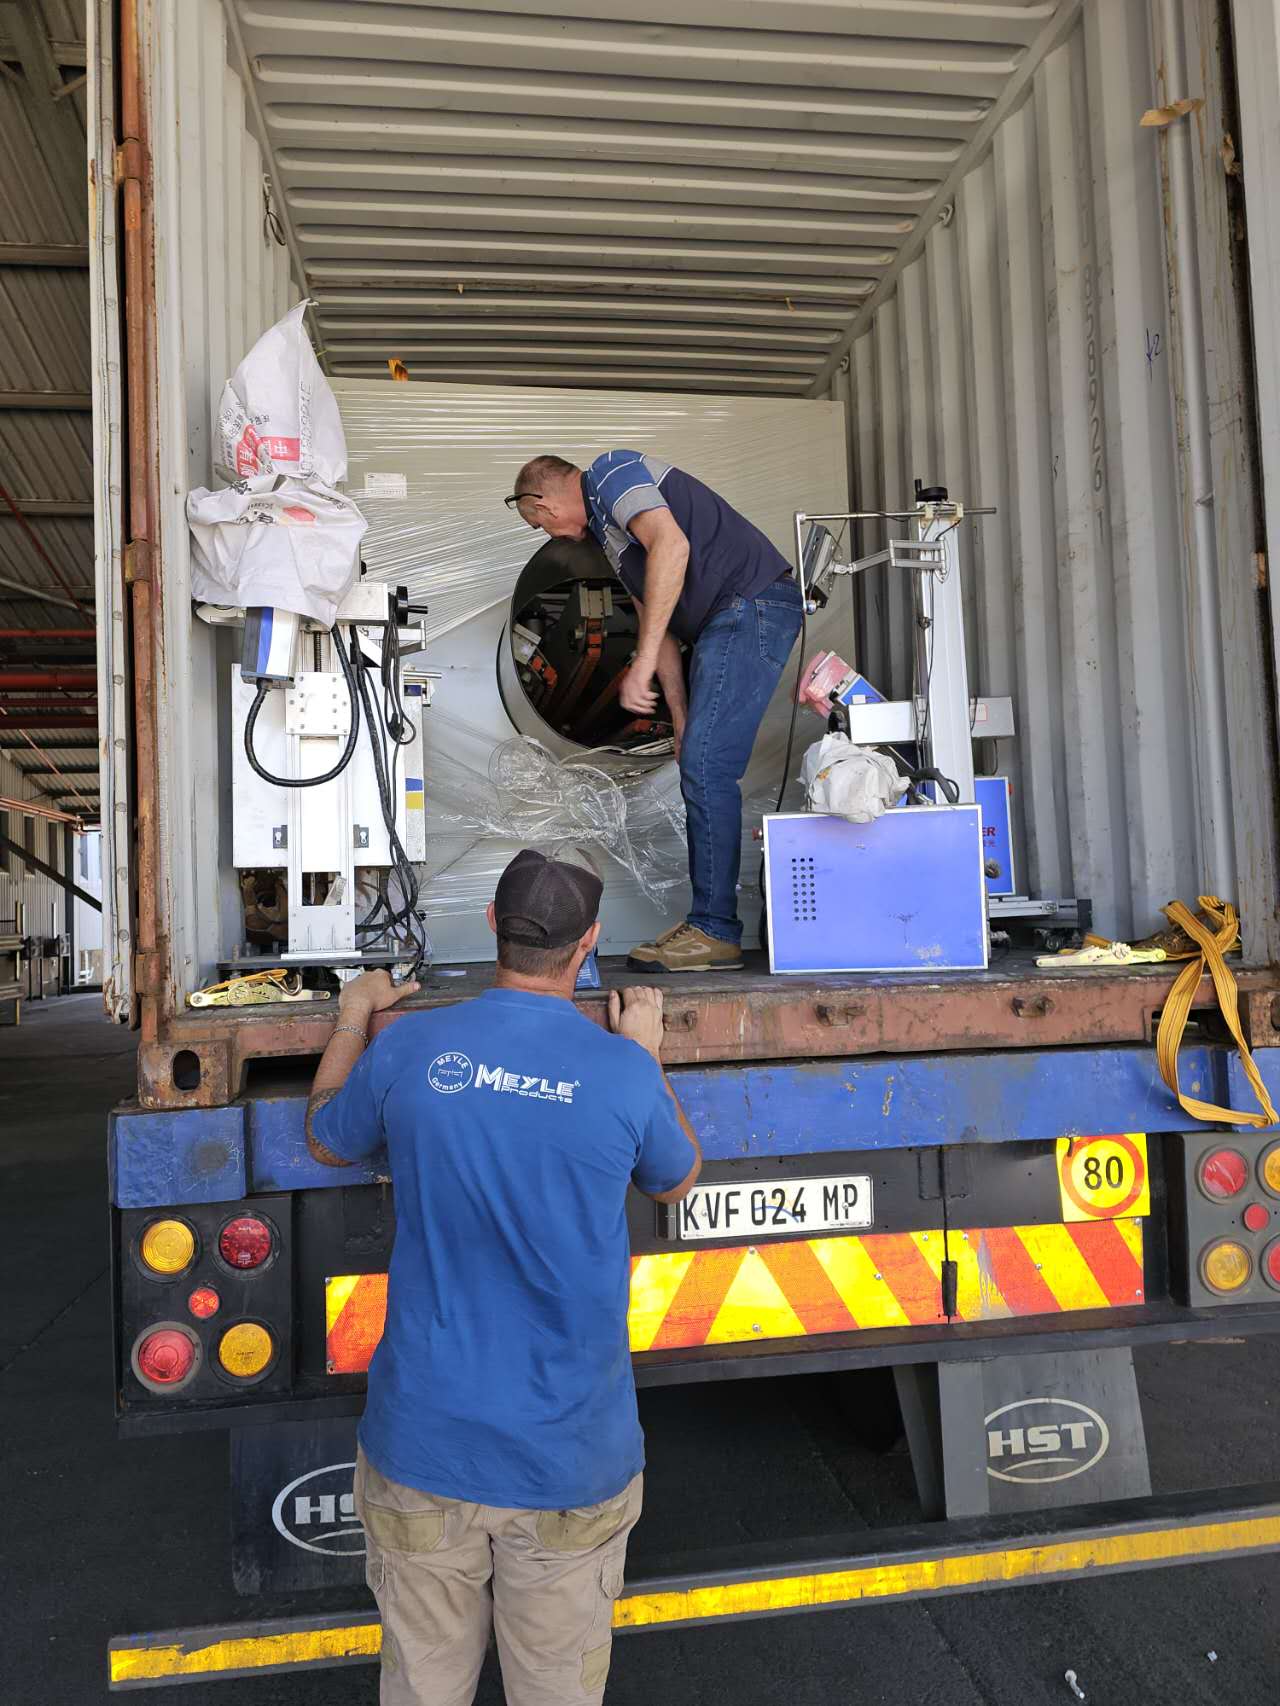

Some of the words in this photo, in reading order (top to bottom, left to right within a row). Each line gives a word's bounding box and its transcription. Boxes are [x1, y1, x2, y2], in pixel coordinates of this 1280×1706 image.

[436, 1054, 469, 1070] MEYLE
[431, 1077, 464, 1091] Germany
[501, 1086, 573, 1104] products
[1084, 1156, 1124, 1190] 80
[683, 1191, 741, 1231] KVF
[751, 1186, 807, 1226] 024
[823, 1183, 858, 1221] MP
[988, 1421, 1094, 1457] HST
